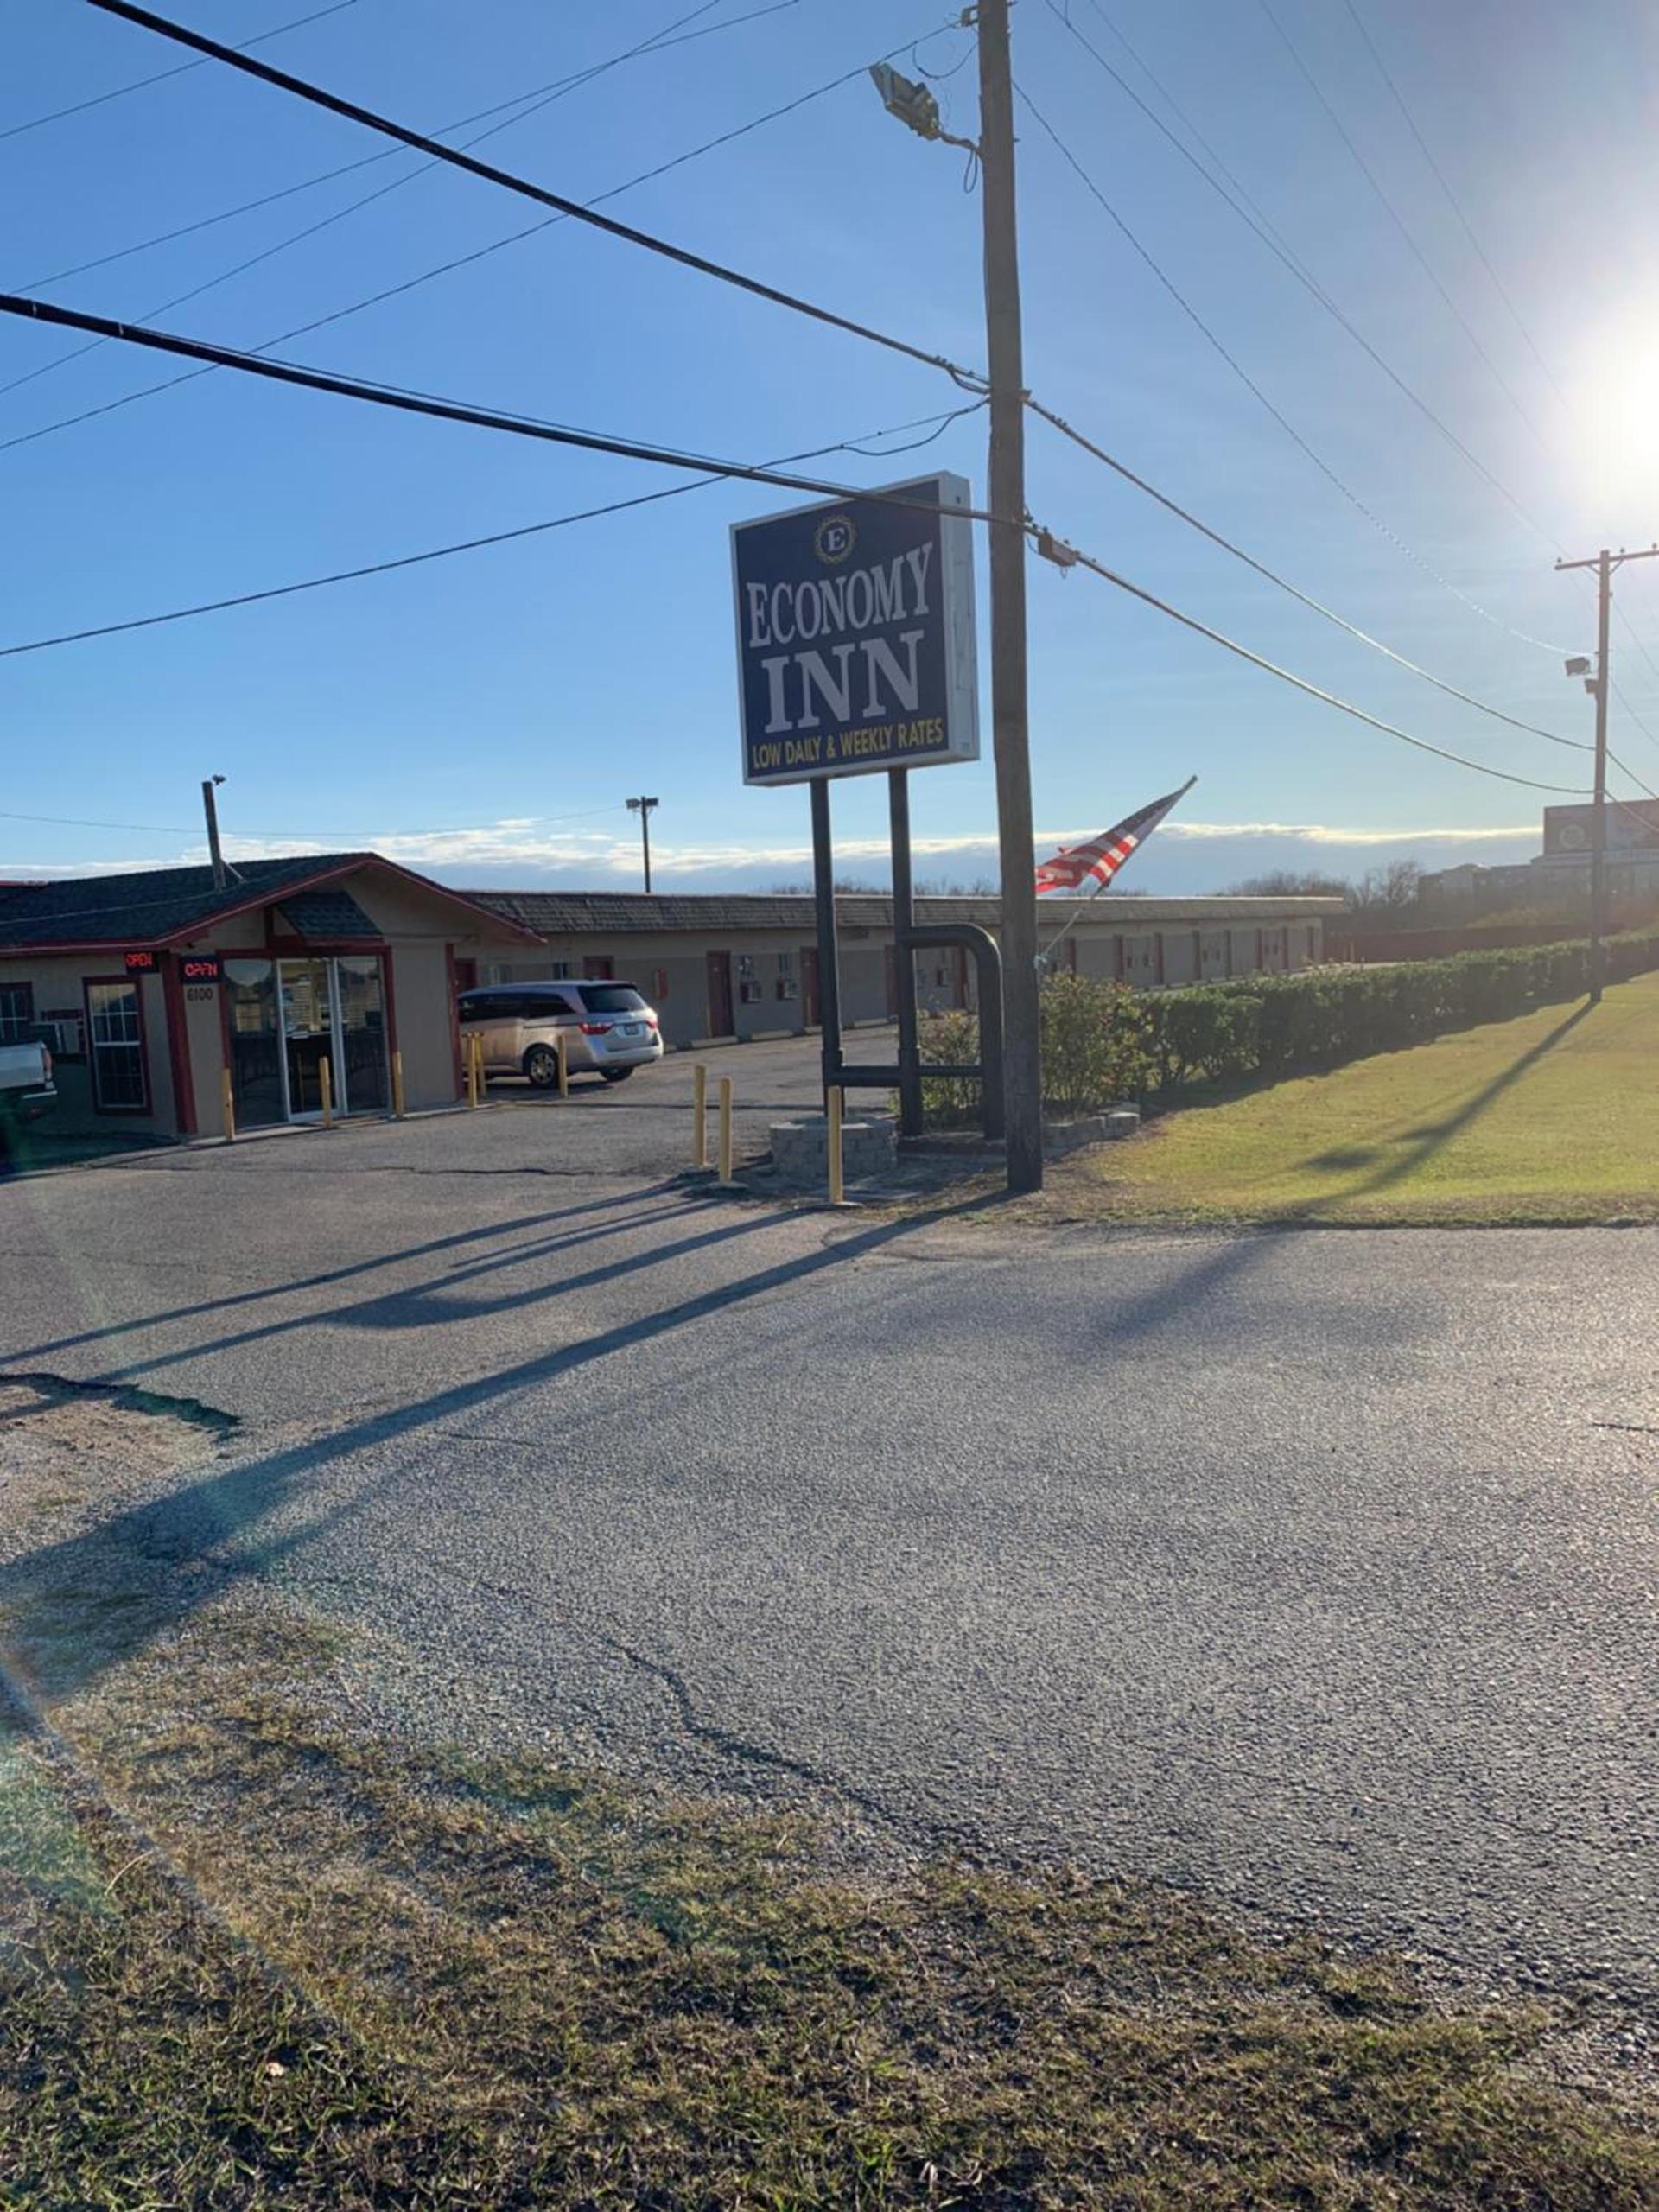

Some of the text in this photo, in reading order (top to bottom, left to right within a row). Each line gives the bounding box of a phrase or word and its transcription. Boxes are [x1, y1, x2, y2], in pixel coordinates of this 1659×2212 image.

[827, 527, 845, 552] E
[747, 541, 933, 648] ECONOMY
[761, 629, 925, 734] INN
[753, 718, 944, 769] LOW DAILY & WEEKLY RATES
[124, 952, 152, 967] OPEN
[187, 988, 213, 1001] 6100
